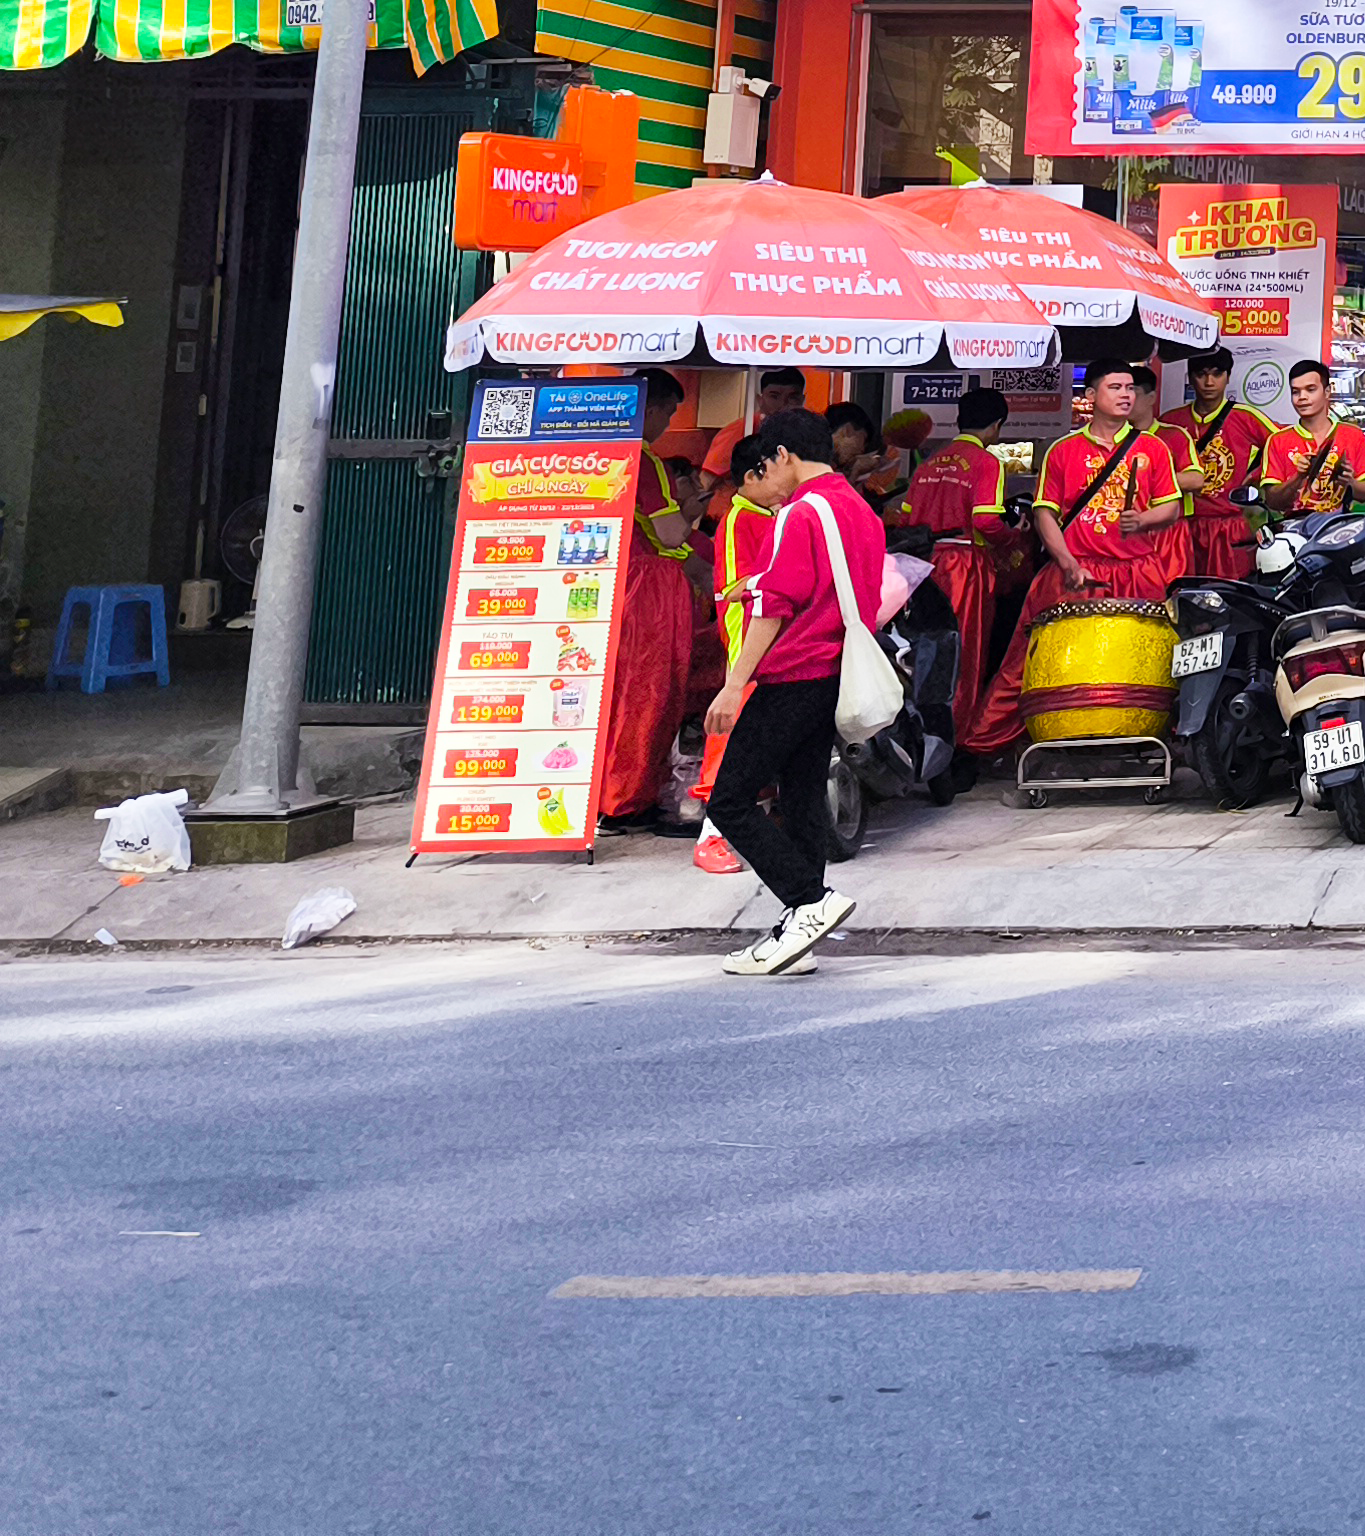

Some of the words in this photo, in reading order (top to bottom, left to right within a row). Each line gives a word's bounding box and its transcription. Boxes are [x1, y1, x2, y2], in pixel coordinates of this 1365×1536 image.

[1300, 11, 1329, 27] SỮA
[1127, 99, 1156, 110] Milk
[1341, 130, 1348, 139] 4
[493, 168, 577, 195] KINGFOOD
[513, 199, 558, 223] mart
[1210, 201, 1284, 226] KHAI
[980, 227, 1028, 243] SIÊU
[1032, 232, 1071, 248] THỊ
[1180, 222, 1312, 252] TRƯƠNG
[632, 240, 718, 259] NGON
[754, 241, 815, 264] SIÊU
[820, 246, 867, 267] THỊ
[1028, 250, 1102, 270] PHẨM
[530, 266, 607, 290] CHẤT
[604, 271, 704, 294] LƯỢNG
[1181, 269, 1212, 280] NƯỚC
[1216, 268, 1248, 280] UỐNG
[1251, 272, 1276, 280] TINH
[1279, 268, 1310, 280] KHIẾT
[730, 272, 807, 296] THỰC
[812, 270, 902, 296] PHẨM
[1192, 283, 1242, 294] QUAFINA
[1225, 299, 1264, 308] 120.000
[911, 387, 938, 398] 7-12
[1246, 377, 1281, 391] AQUAFINA
[584, 392, 628, 402] OneLife
[491, 454, 524, 474] GIÁ
[529, 454, 567, 474] CỰC
[571, 451, 610, 472] SỐC
[507, 479, 531, 494] CHỈ
[535, 481, 545, 491] 4
[548, 480, 588, 492] NGÀY
[485, 546, 534, 562] 29.000
[477, 599, 526, 614] 39.000
[469, 652, 518, 668] 69.000
[1174, 652, 1217, 676] 257.42
[457, 705, 518, 722] 139.000
[1313, 727, 1351, 750] 59-U1
[1310, 744, 1360, 770] 314.60
[455, 759, 506, 776] 99.000
[448, 815, 499, 831] 15.000
